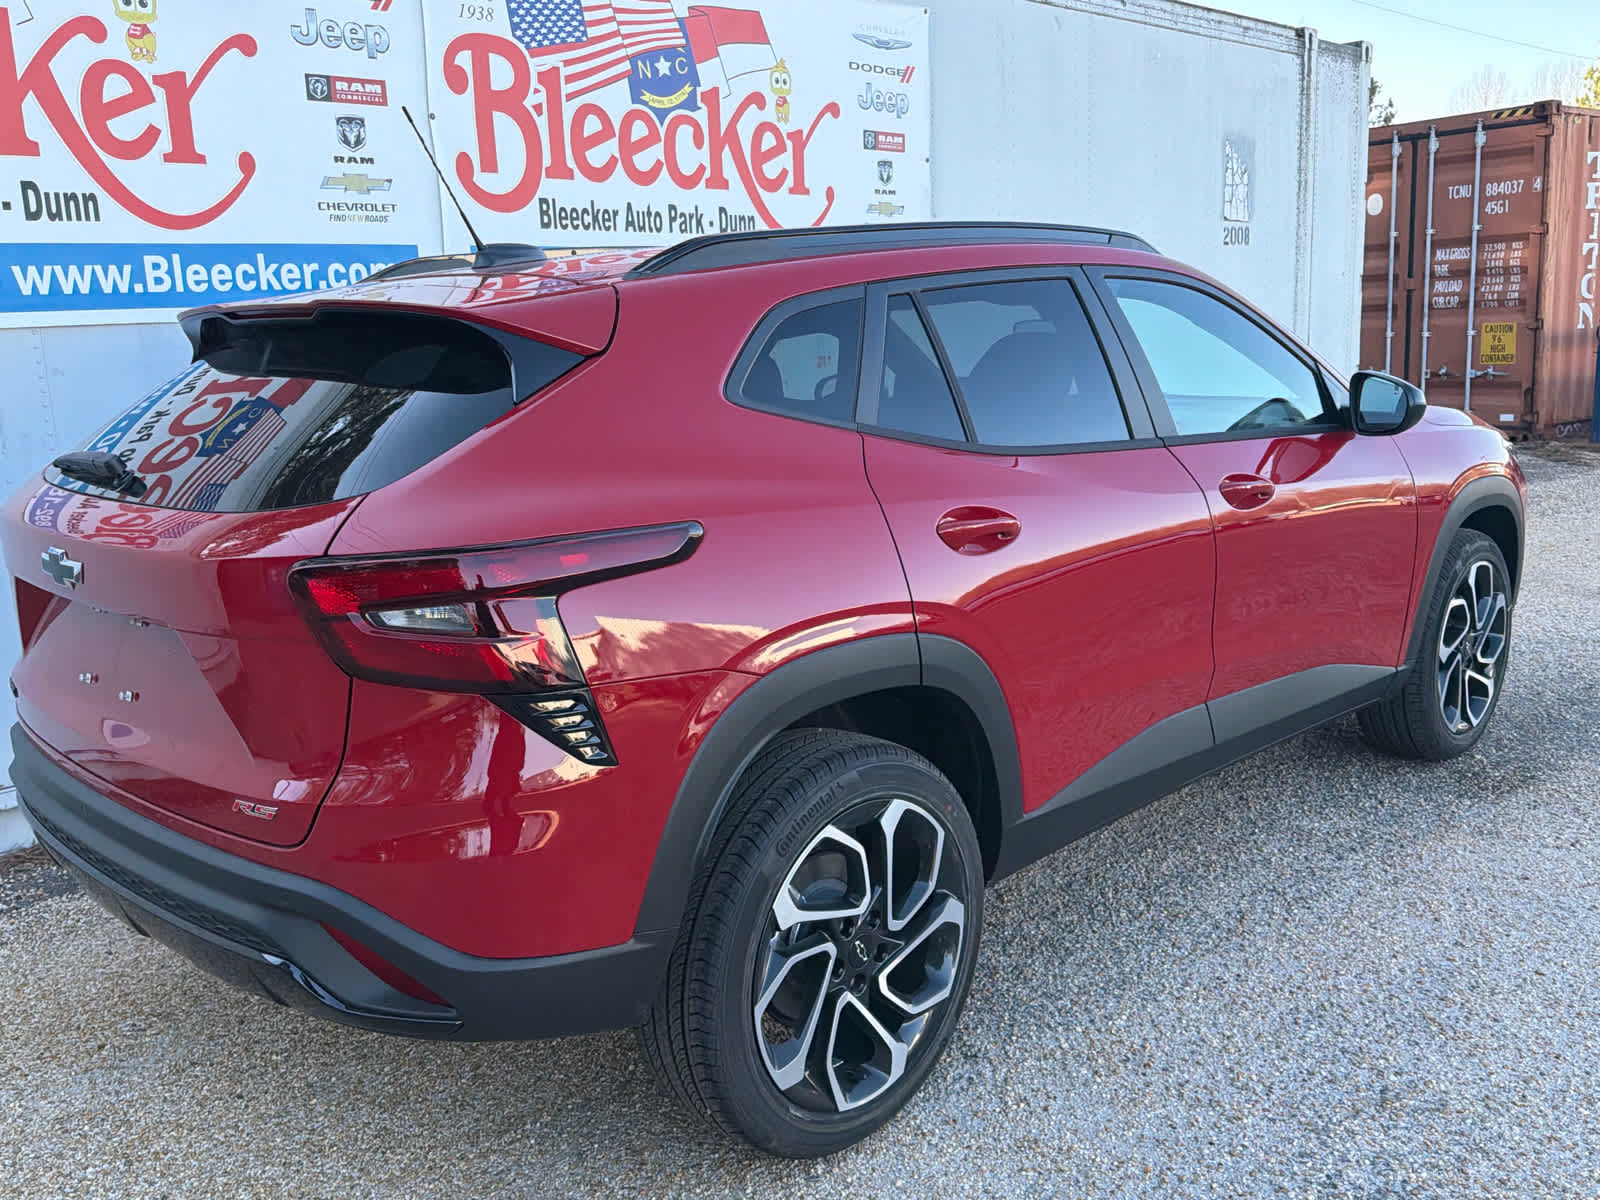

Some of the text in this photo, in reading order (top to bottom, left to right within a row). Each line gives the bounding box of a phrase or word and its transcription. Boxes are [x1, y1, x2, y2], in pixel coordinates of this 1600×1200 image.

[458, 4, 494, 22] 1938
[290, 8, 390, 59] Jeep
[637, 57, 689, 79] N C
[848, 61, 905, 77] DODGE
[335, 81, 382, 93] RAM
[336, 94, 383, 103] COMMERCIAL
[857, 82, 909, 119] Jeep
[443, 32, 840, 229] Bleecker
[878, 135, 903, 144] RAM
[333, 156, 375, 165] RAM
[874, 188, 896, 196] RAM
[1448, 176, 1542, 199] TCNU 884037 4
[20, 180, 101, 222] Dunn
[317, 201, 398, 213] CHEVROLET
[538, 197, 619, 231] Bleecker
[625, 202, 663, 233] Auto
[668, 204, 705, 234] Park
[718, 206, 755, 233] Dunn
[1223, 226, 1250, 246] 2008
[1484, 324, 1514, 334] CAUTION
[1490, 343, 1506, 353] HIGH
[1480, 353, 1514, 363] CONTAINER
[231, 799, 279, 820] RS
